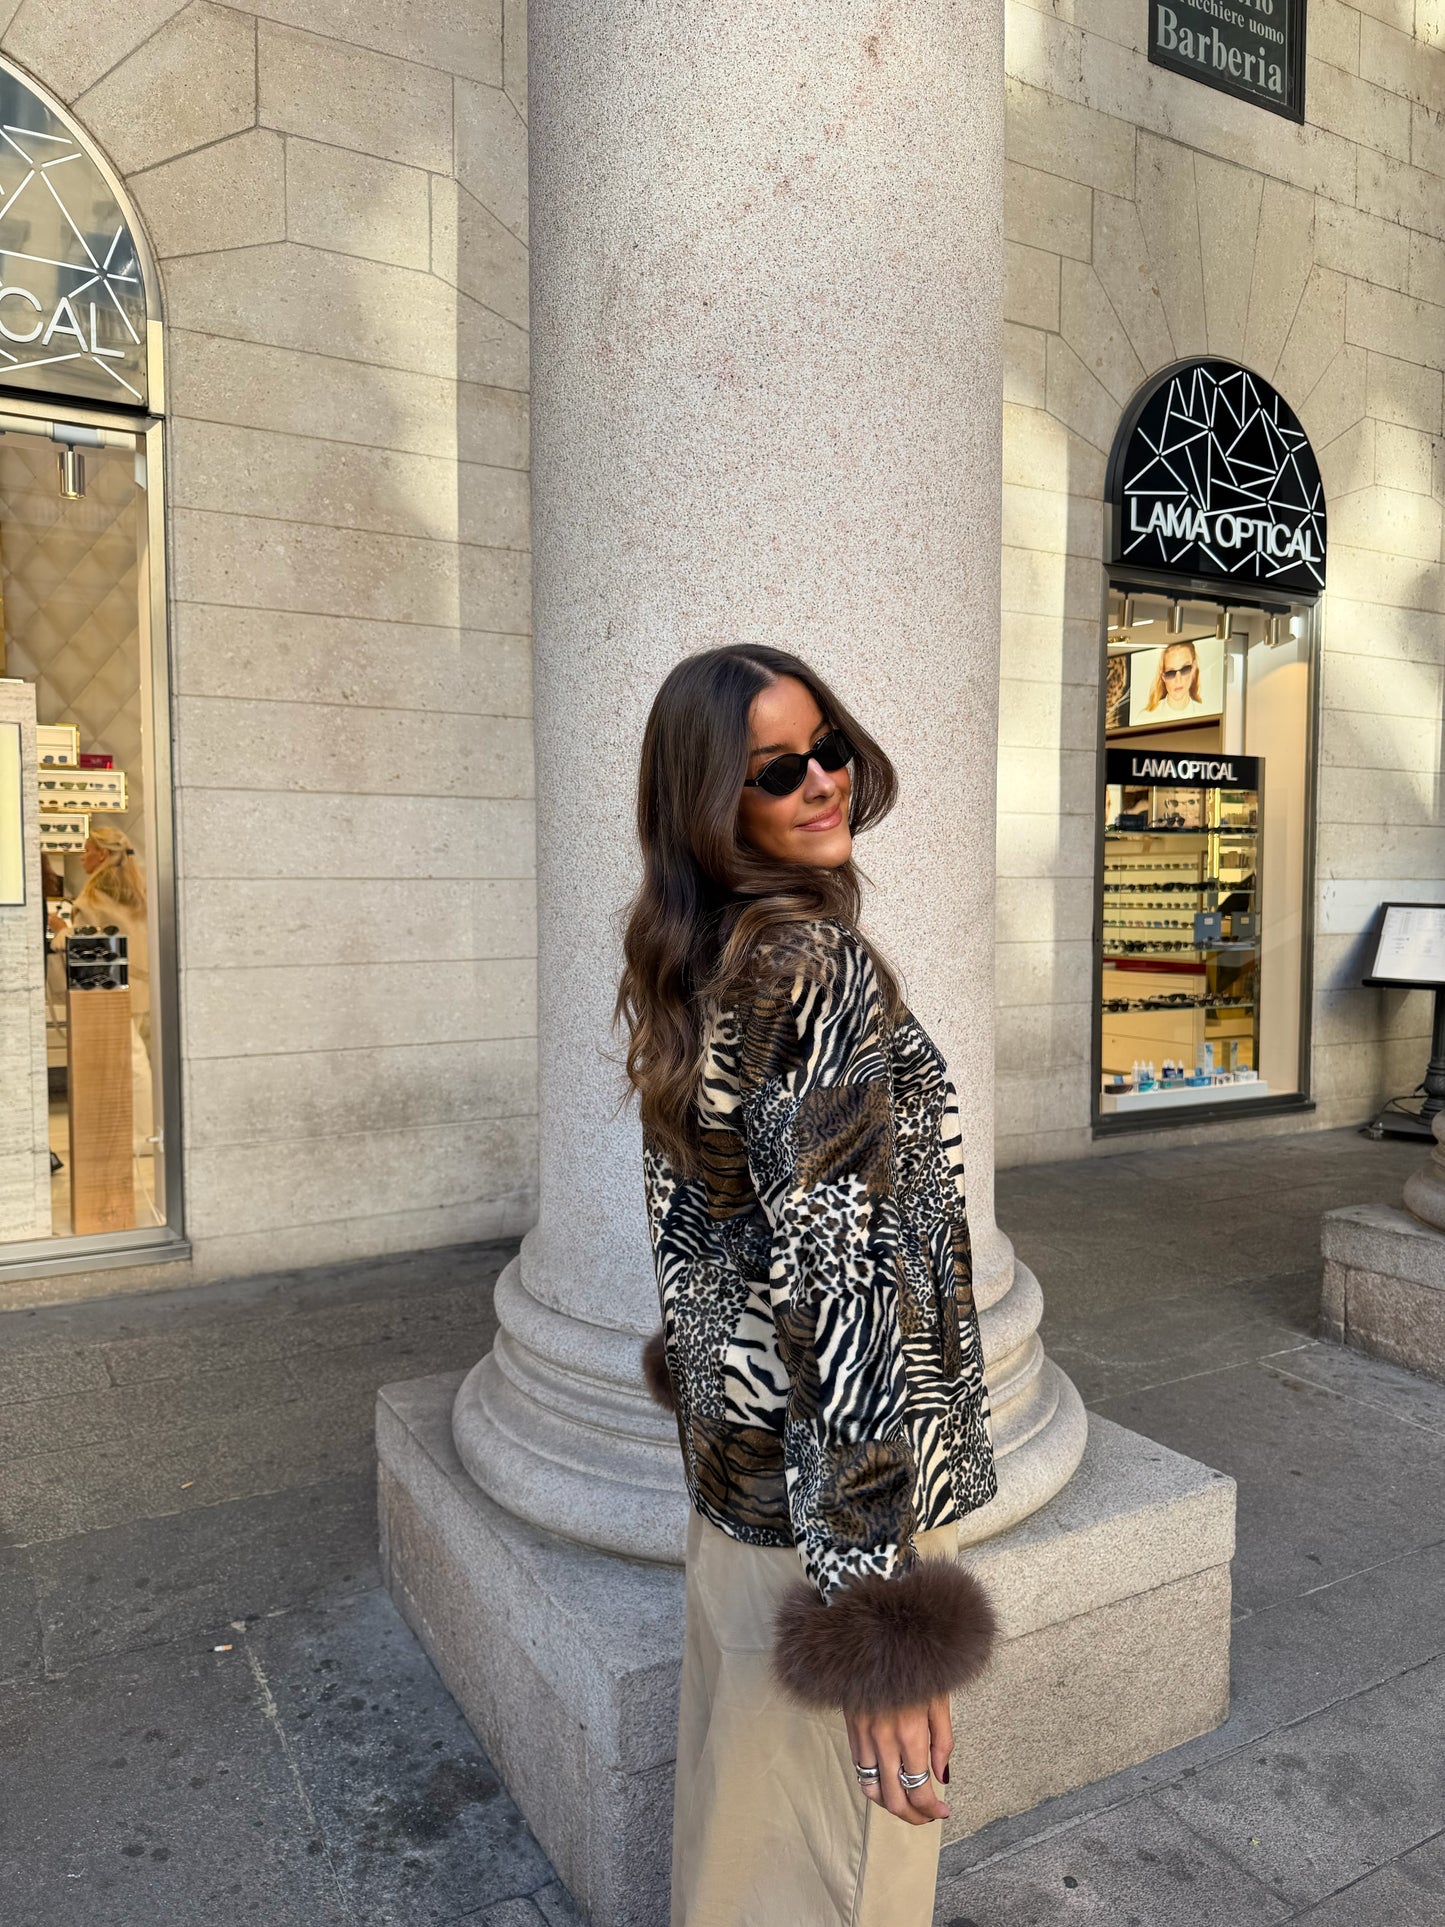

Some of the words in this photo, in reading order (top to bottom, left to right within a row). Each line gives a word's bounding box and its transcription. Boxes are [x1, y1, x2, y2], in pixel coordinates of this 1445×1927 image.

[1156, 4, 1283, 93] Barberia
[1249, 19, 1284, 45] uomo
[0, 286, 125, 359] CAL
[1131, 497, 1211, 543] LAMA
[1215, 513, 1321, 562] OPTICAL
[1132, 757, 1177, 778] LAMA
[1177, 759, 1238, 781] OPTICAL
